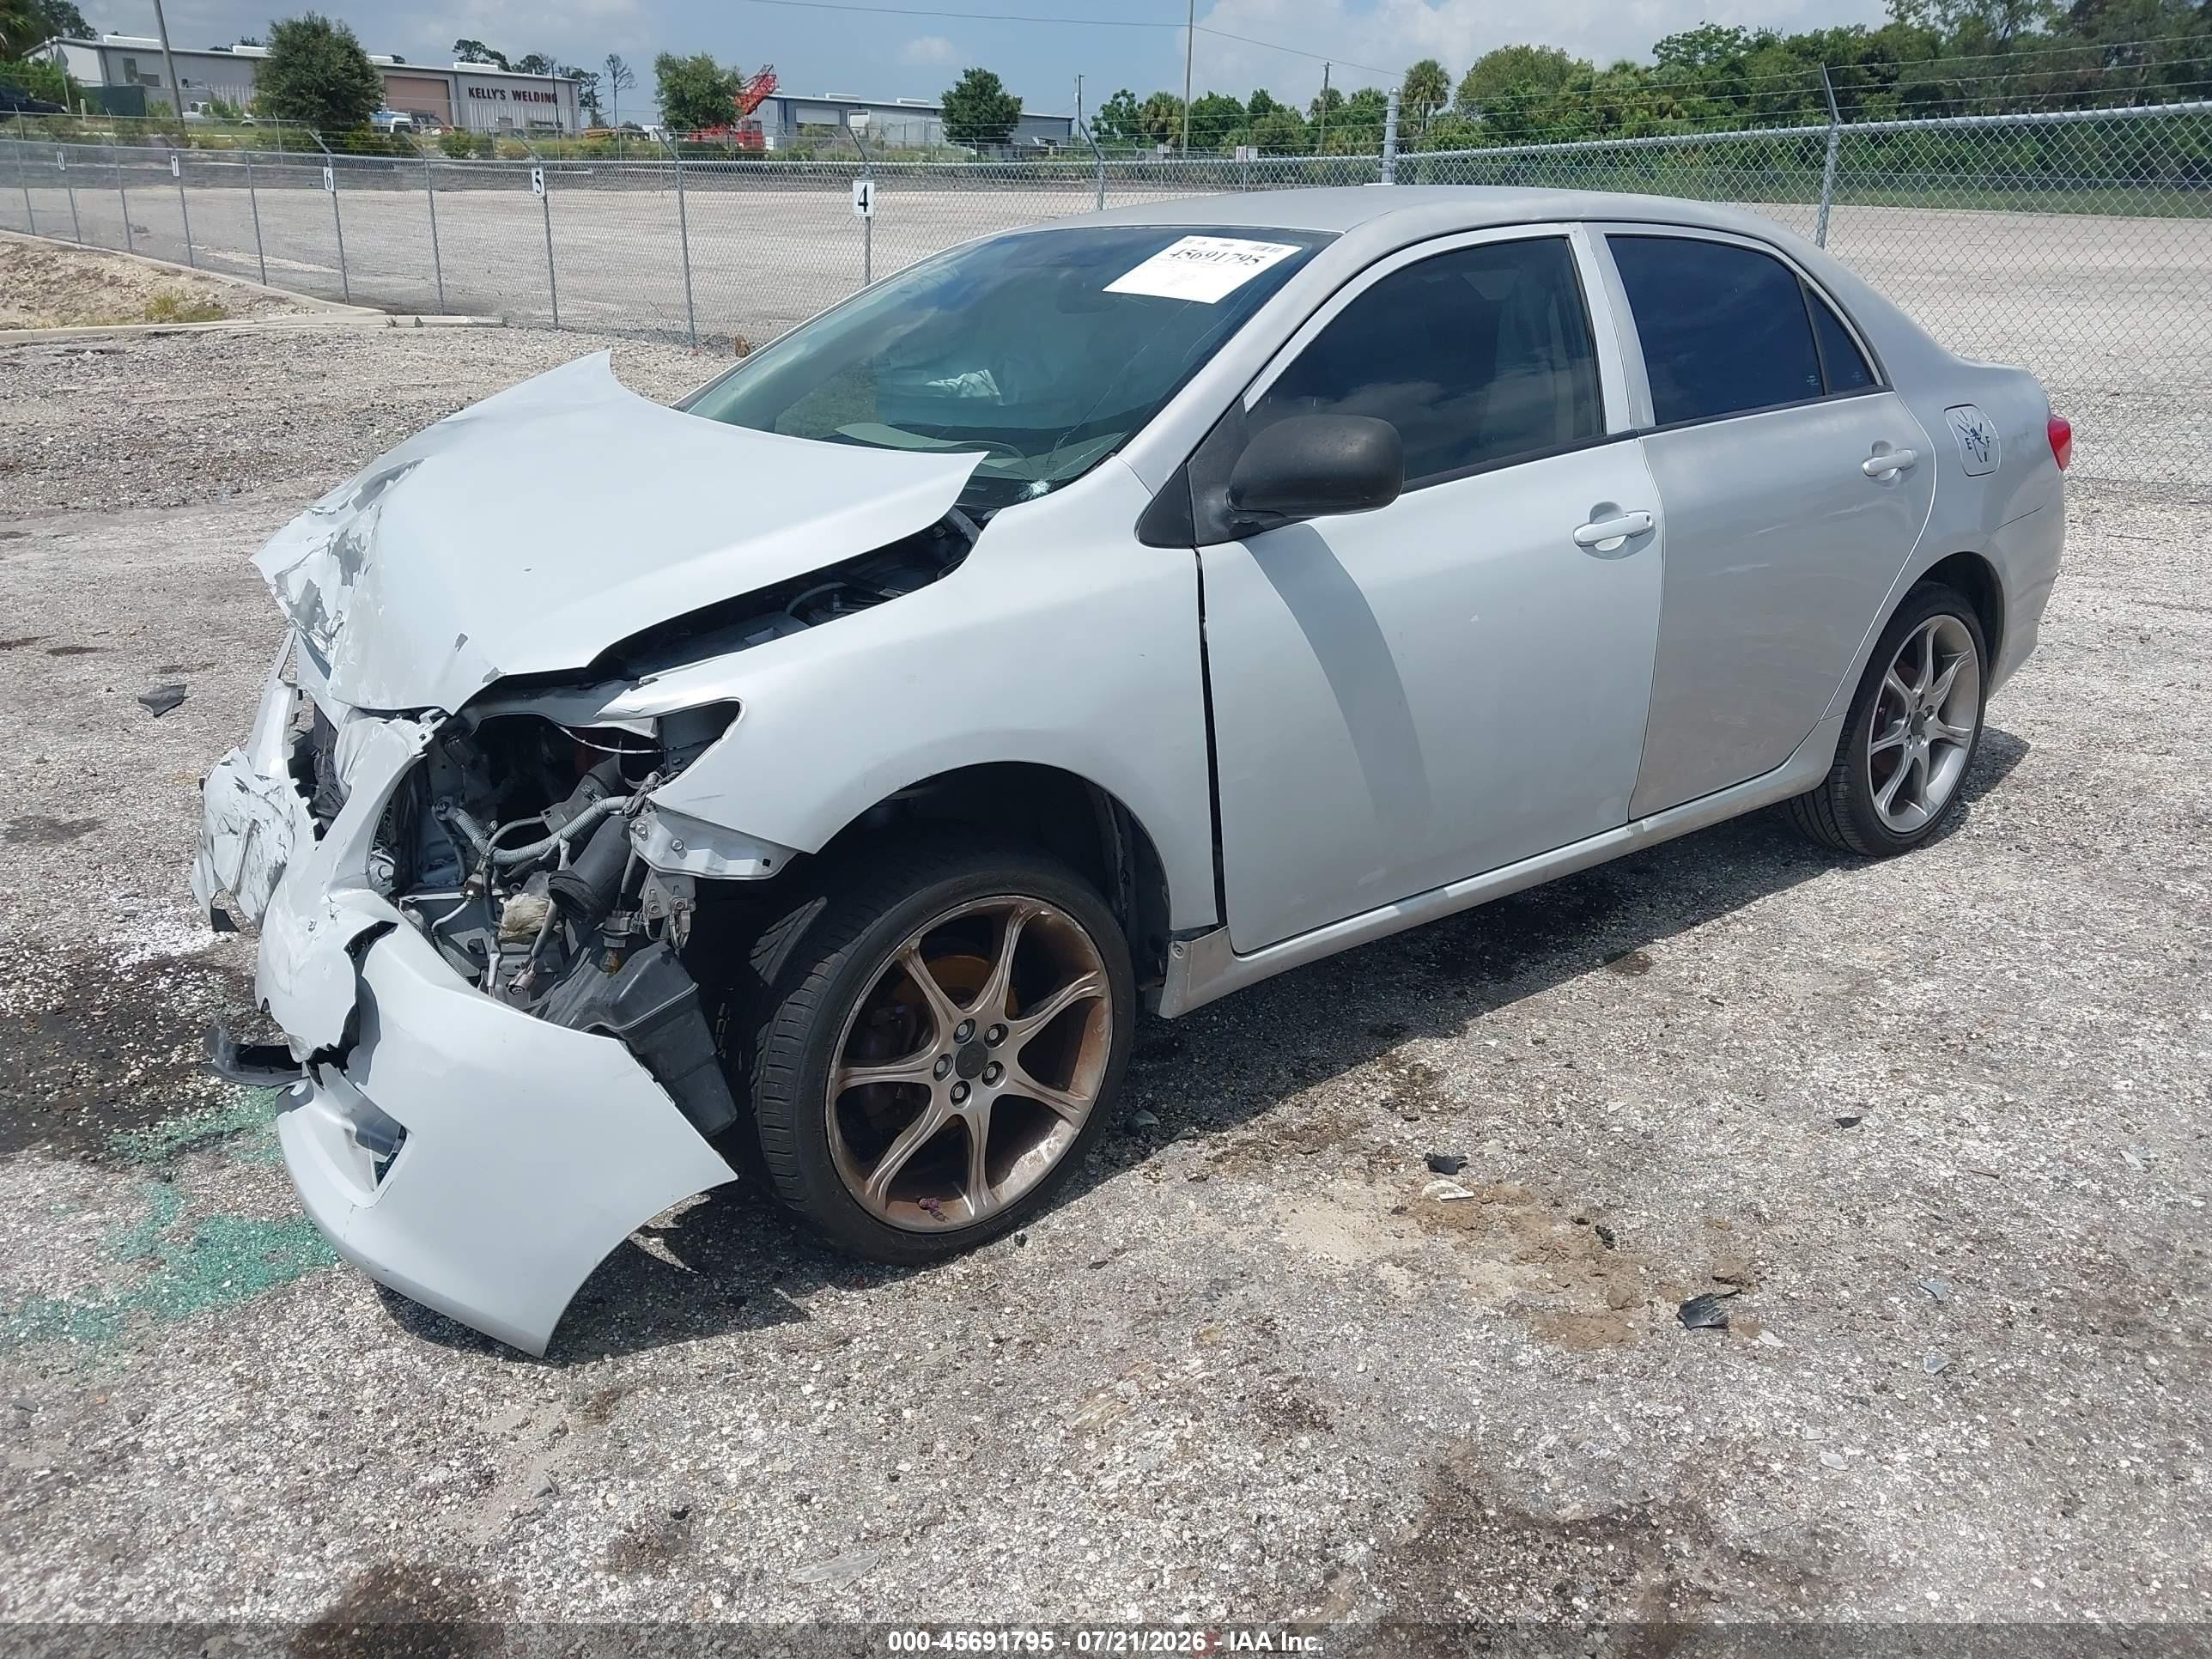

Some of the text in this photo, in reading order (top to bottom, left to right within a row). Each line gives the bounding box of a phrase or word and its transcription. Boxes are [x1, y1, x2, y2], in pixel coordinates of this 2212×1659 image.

[468, 87, 506, 100] KELLY'S
[326, 170, 331, 189] 6
[535, 171, 542, 194] 5
[858, 184, 869, 213] 4
[1169, 249, 1266, 265] 45691795
